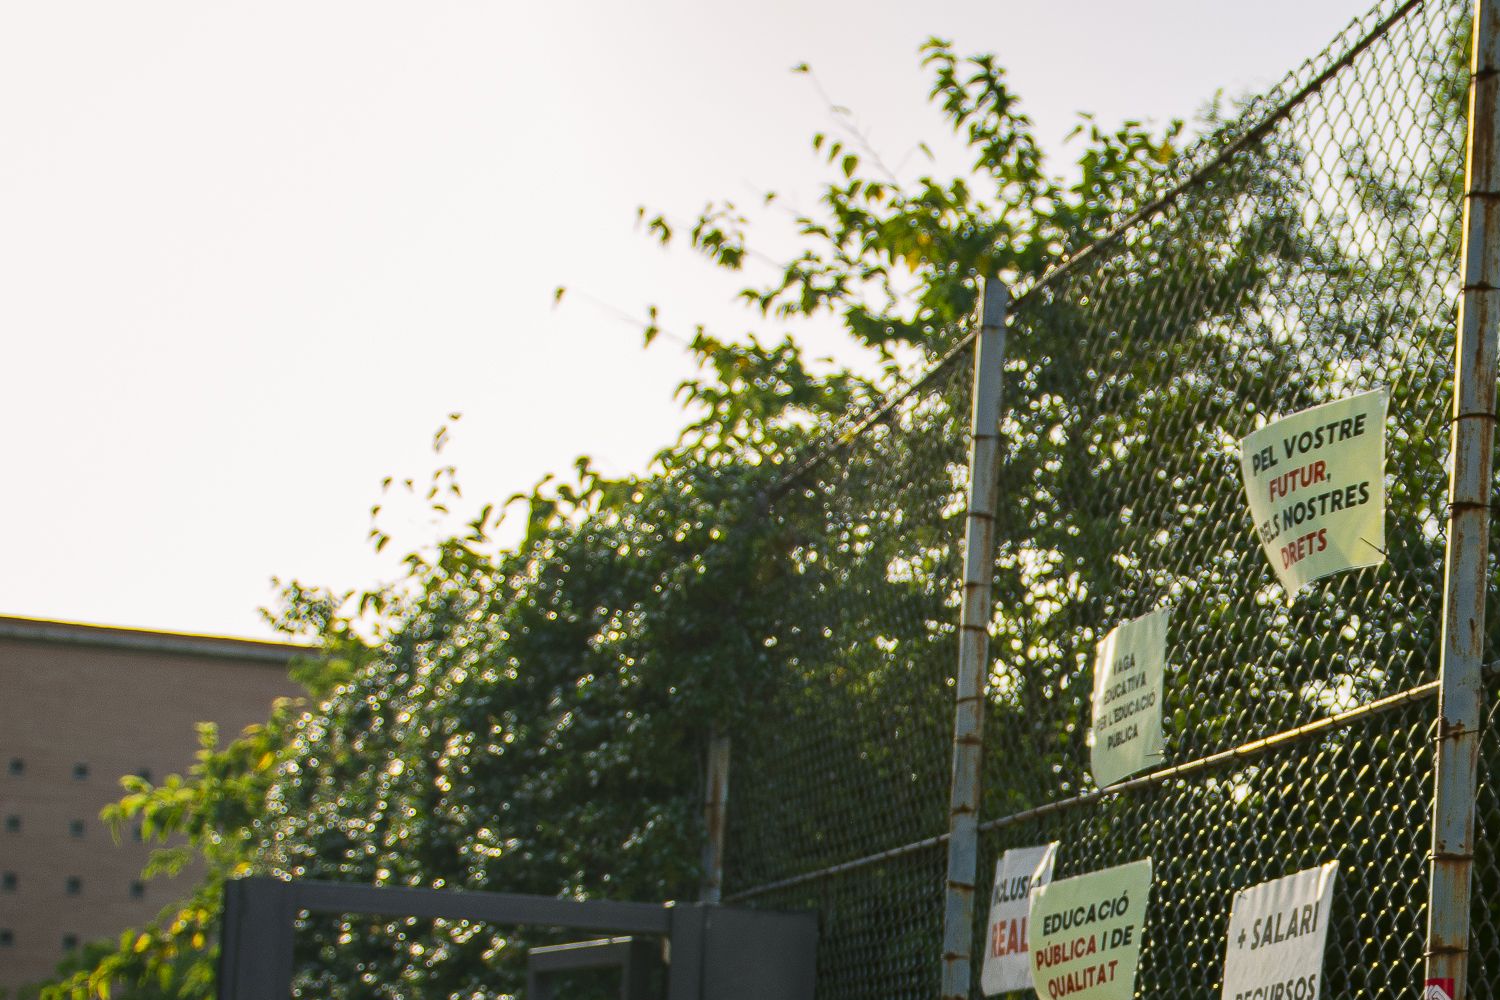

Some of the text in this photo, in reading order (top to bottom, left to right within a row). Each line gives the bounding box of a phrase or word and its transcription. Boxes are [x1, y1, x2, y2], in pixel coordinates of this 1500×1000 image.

[1252, 413, 1367, 477] PEL VOSTRE
[1269, 460, 1331, 503] FUTUR,
[1283, 481, 1370, 532] NOSTRES
[1280, 528, 1328, 570] DRETS
[1043, 890, 1129, 936] EDUCACIÓ
[1251, 901, 1320, 950] SALARI
[1036, 925, 1134, 971] PÚBLICA I DE
